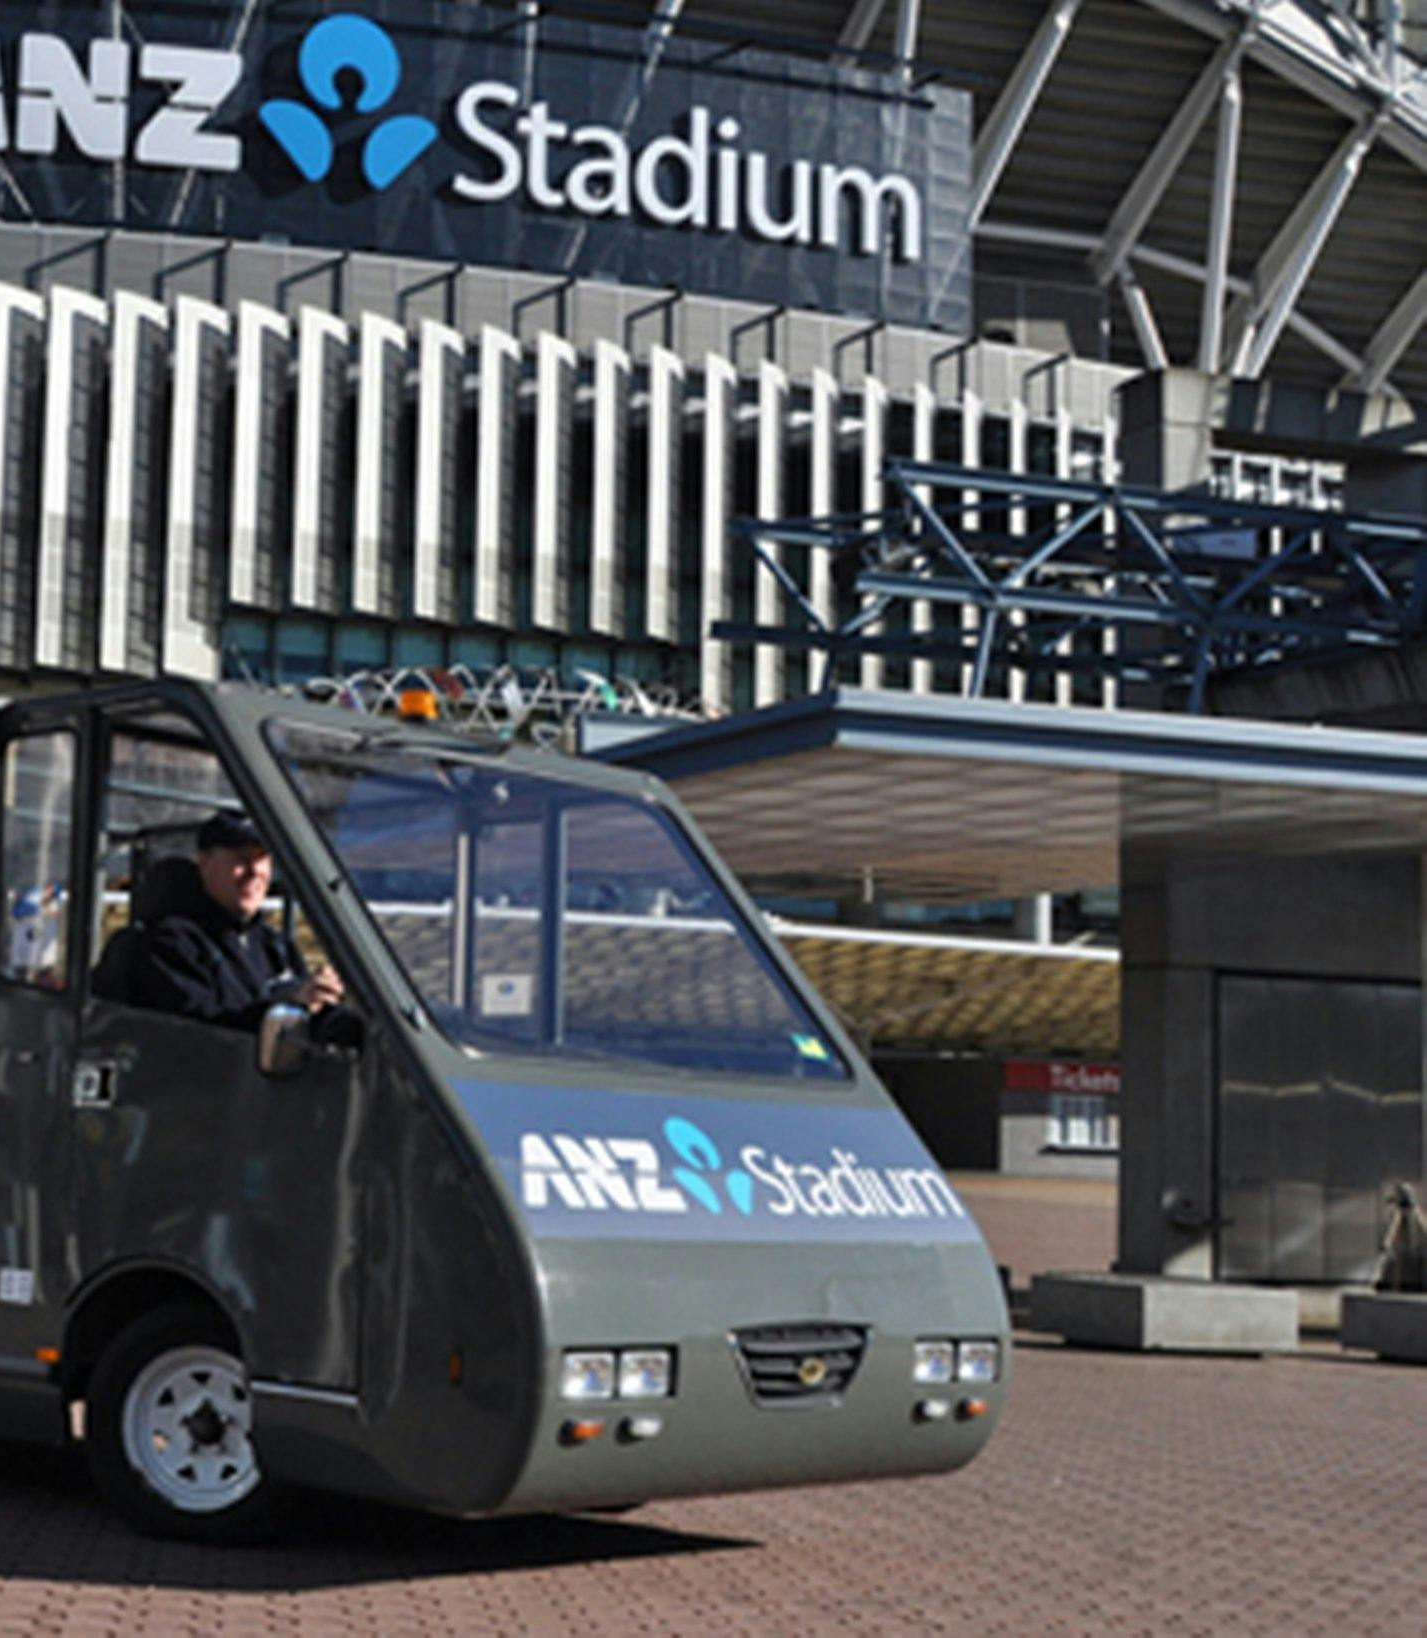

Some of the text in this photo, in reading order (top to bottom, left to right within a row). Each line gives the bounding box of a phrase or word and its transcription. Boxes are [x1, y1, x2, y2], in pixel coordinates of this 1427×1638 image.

[452, 80, 922, 261] Stadium
[520, 1133, 965, 1218] ANZ Stadium
